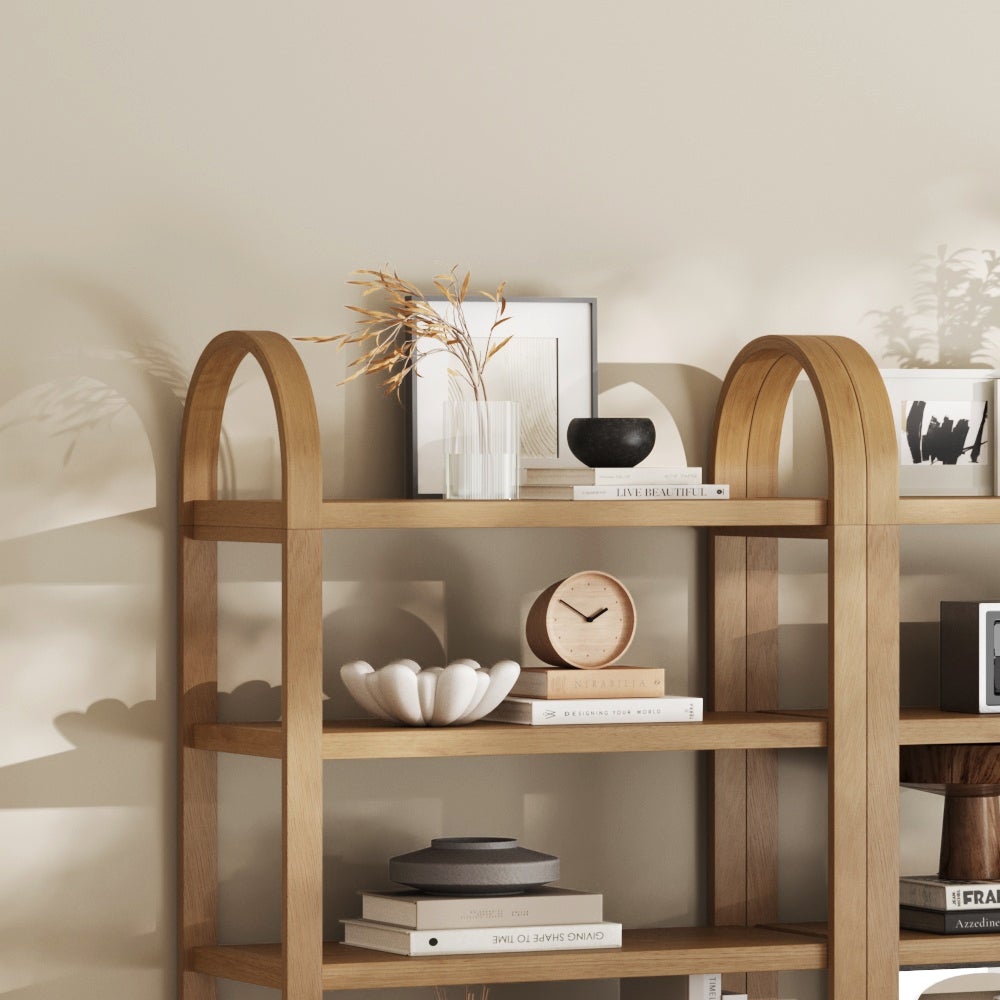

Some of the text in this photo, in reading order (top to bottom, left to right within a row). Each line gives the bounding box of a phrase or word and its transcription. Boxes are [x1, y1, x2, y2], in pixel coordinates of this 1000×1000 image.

[616, 487, 642, 497] LIVE
[645, 487, 708, 497] BEAUTIFUL
[955, 916, 1000, 929] Azzedine
[492, 931, 605, 944] GIVING SHAPE TO TIME
